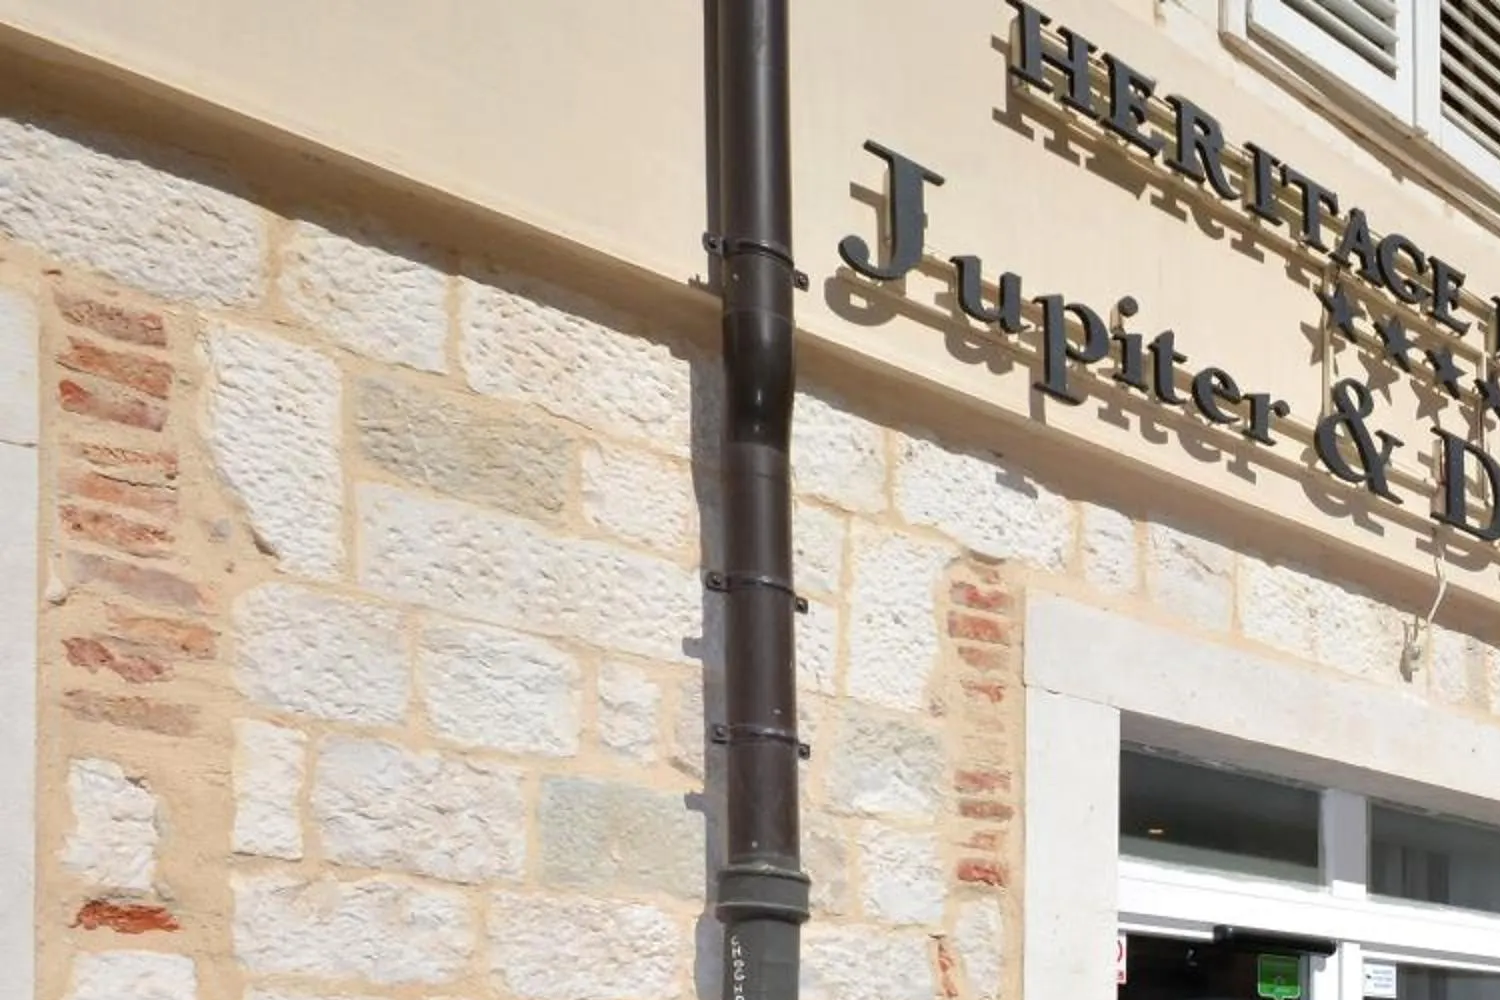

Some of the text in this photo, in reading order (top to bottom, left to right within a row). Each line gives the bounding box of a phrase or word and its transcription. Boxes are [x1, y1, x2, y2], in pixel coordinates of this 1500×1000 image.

[838, 139, 1291, 449] Jupiter
[1314, 377, 1405, 503] &
[1009, 2, 1473, 337] HERITAGE
